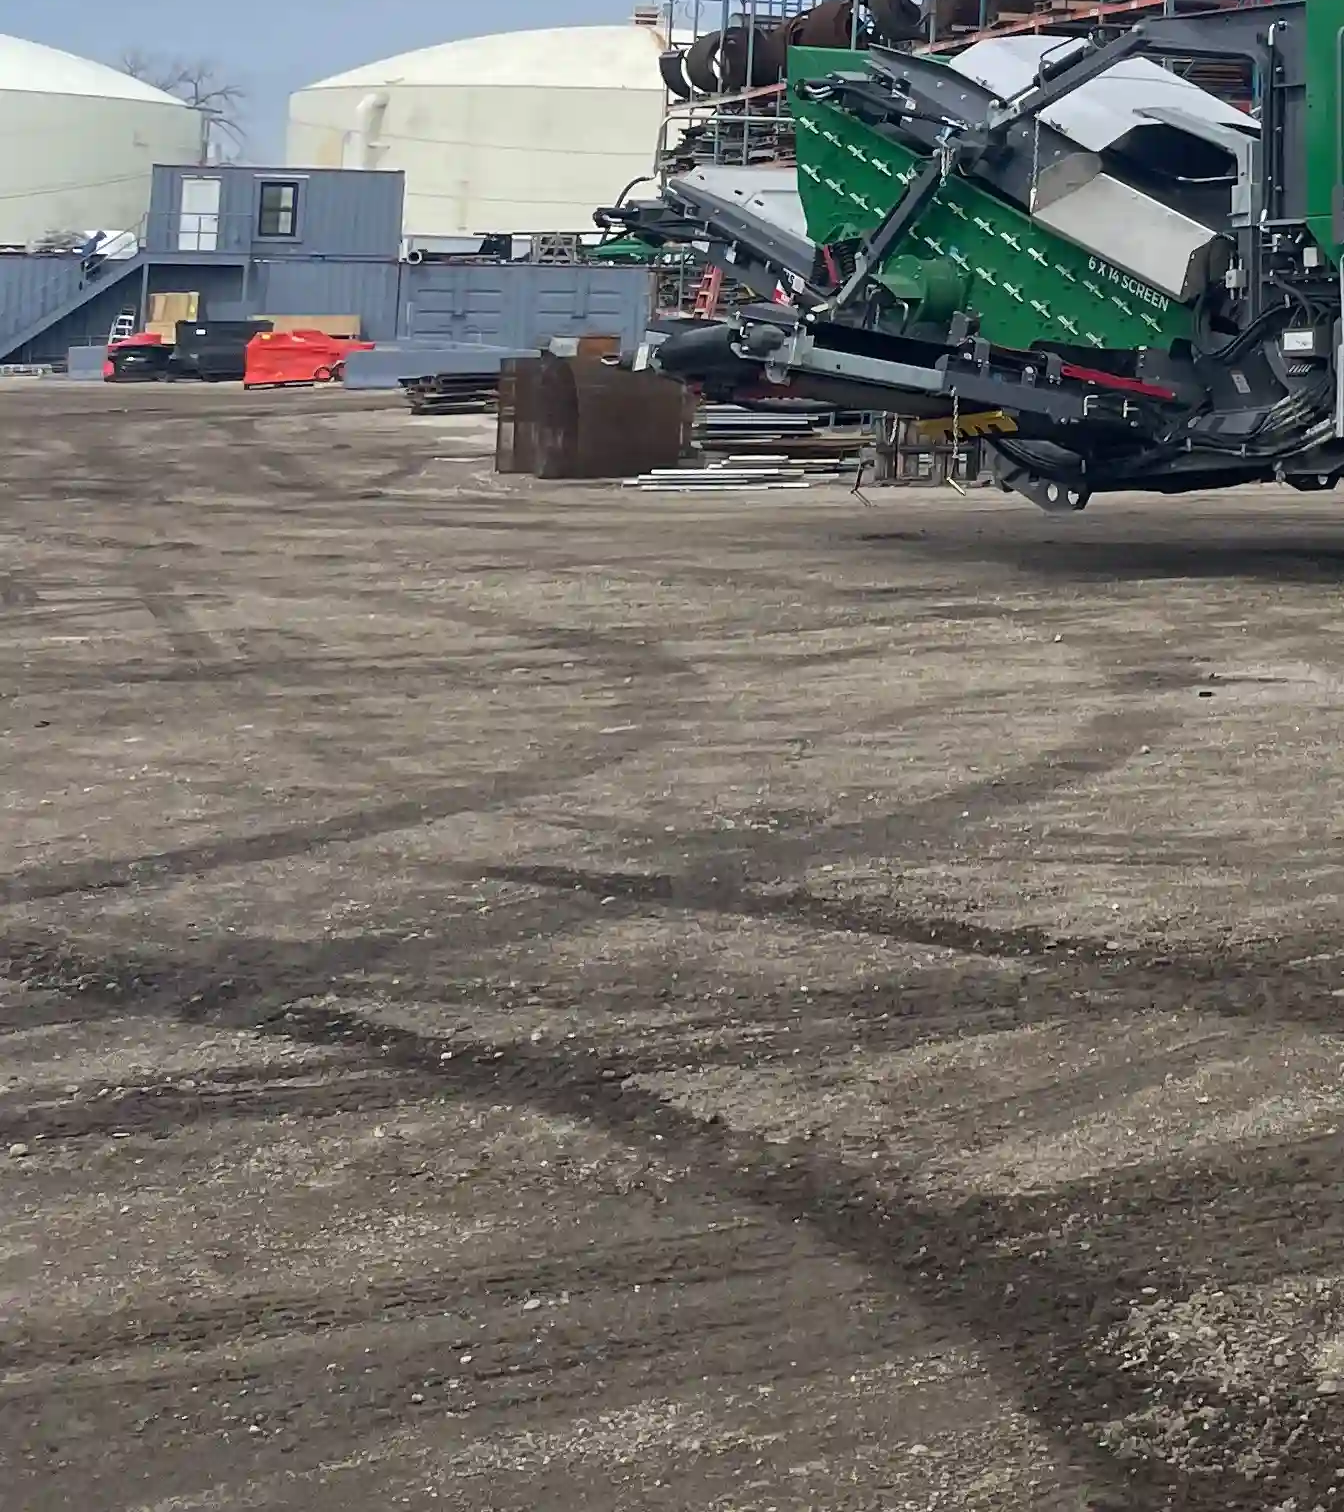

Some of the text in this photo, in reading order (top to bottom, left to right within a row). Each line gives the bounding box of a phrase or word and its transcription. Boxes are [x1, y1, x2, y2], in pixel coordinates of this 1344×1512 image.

[1088, 255, 1169, 312] 6 X 14 SCREEN
